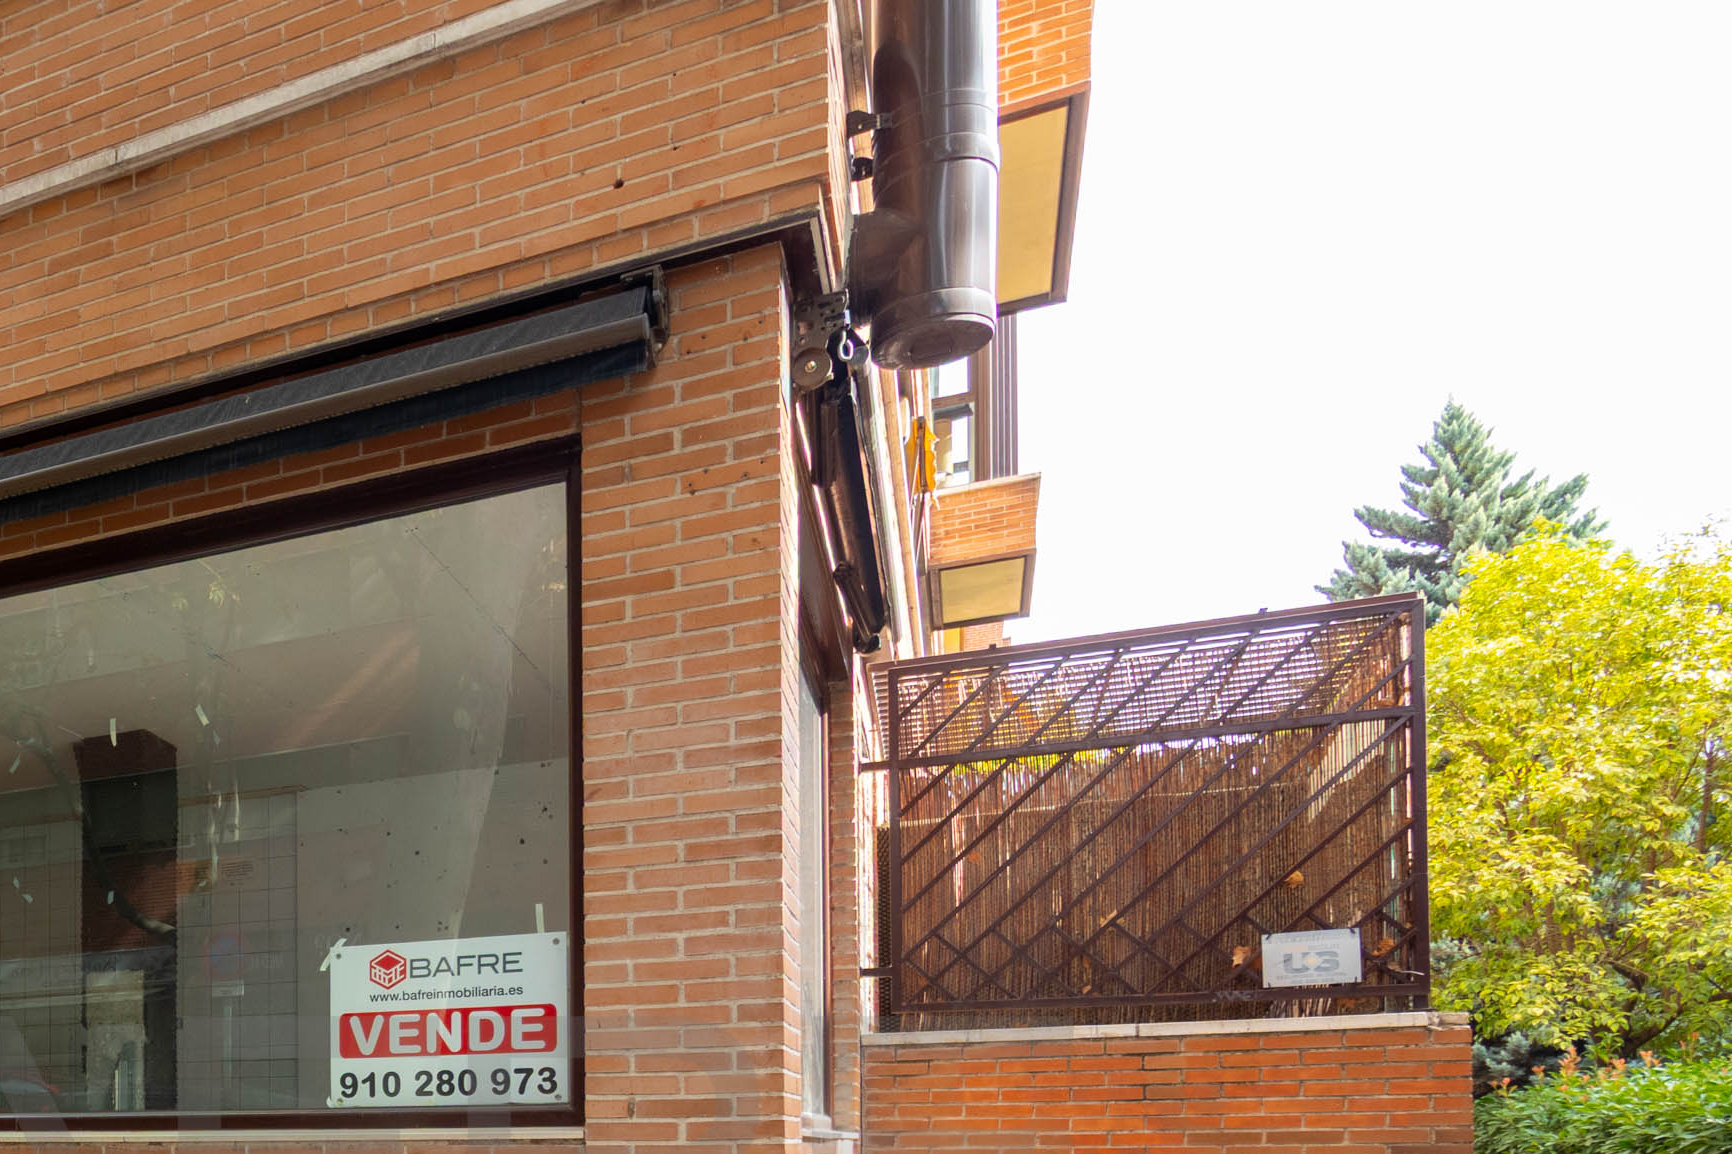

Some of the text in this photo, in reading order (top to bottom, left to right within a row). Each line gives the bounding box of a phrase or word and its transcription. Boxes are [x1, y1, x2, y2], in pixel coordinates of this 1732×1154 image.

[409, 951, 524, 979] BAFRE
[369, 986, 524, 1003] www.bafreinmobiliaria.es
[349, 1007, 546, 1056] VENDE
[339, 1067, 558, 1099] 910 280 973
